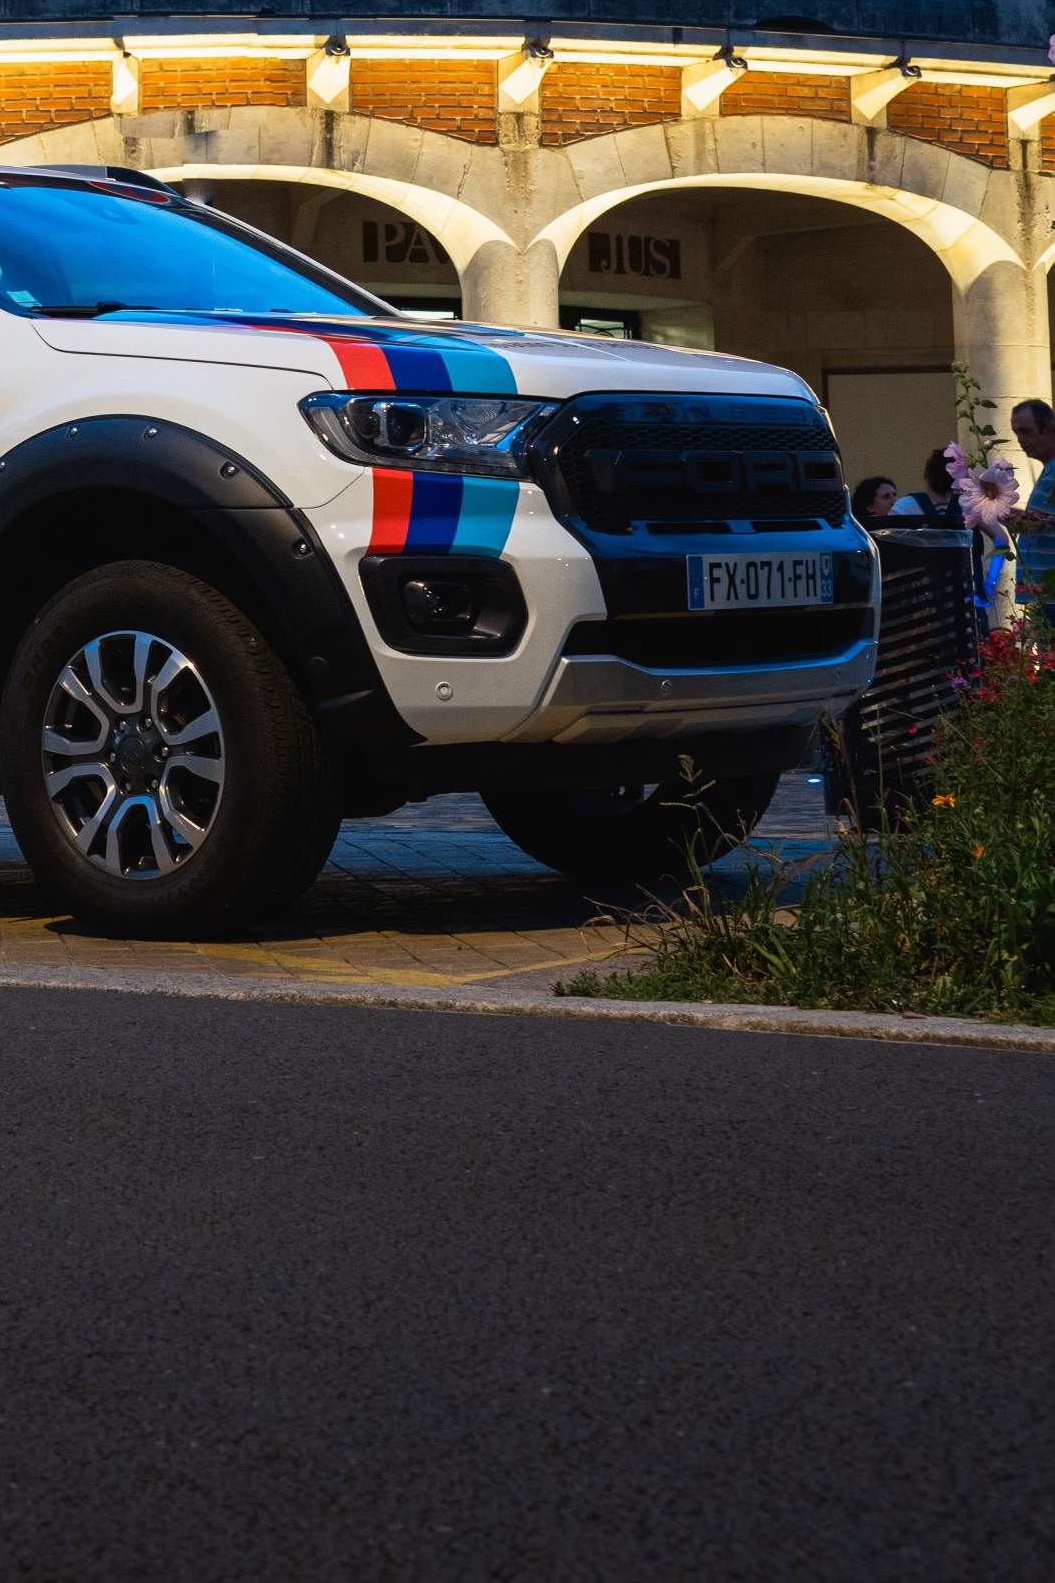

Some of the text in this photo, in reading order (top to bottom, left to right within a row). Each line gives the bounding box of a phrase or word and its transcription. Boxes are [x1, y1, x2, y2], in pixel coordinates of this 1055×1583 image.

[375, 221, 450, 264] PA
[600, 232, 672, 278] JUS
[615, 403, 807, 422] RANGER
[585, 449, 844, 495] FORD
[709, 559, 818, 602] FX-071-FH
[820, 579, 832, 598] 33
